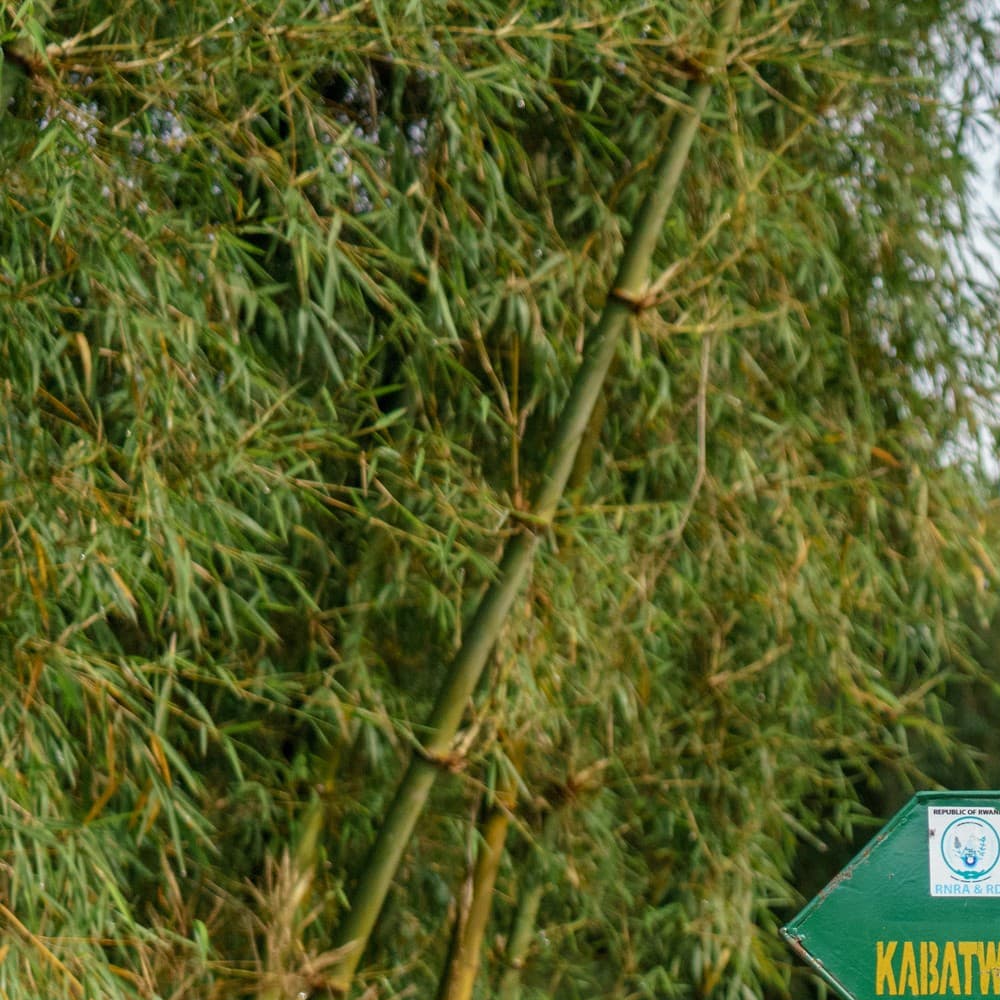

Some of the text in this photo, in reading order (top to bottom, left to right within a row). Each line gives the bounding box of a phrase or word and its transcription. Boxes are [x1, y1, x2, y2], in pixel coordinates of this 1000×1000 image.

[933, 808, 967, 816] REPUBLIC
[967, 808, 977, 816] OF
[935, 884, 970, 894] RNRA
[974, 884, 983, 894] &
